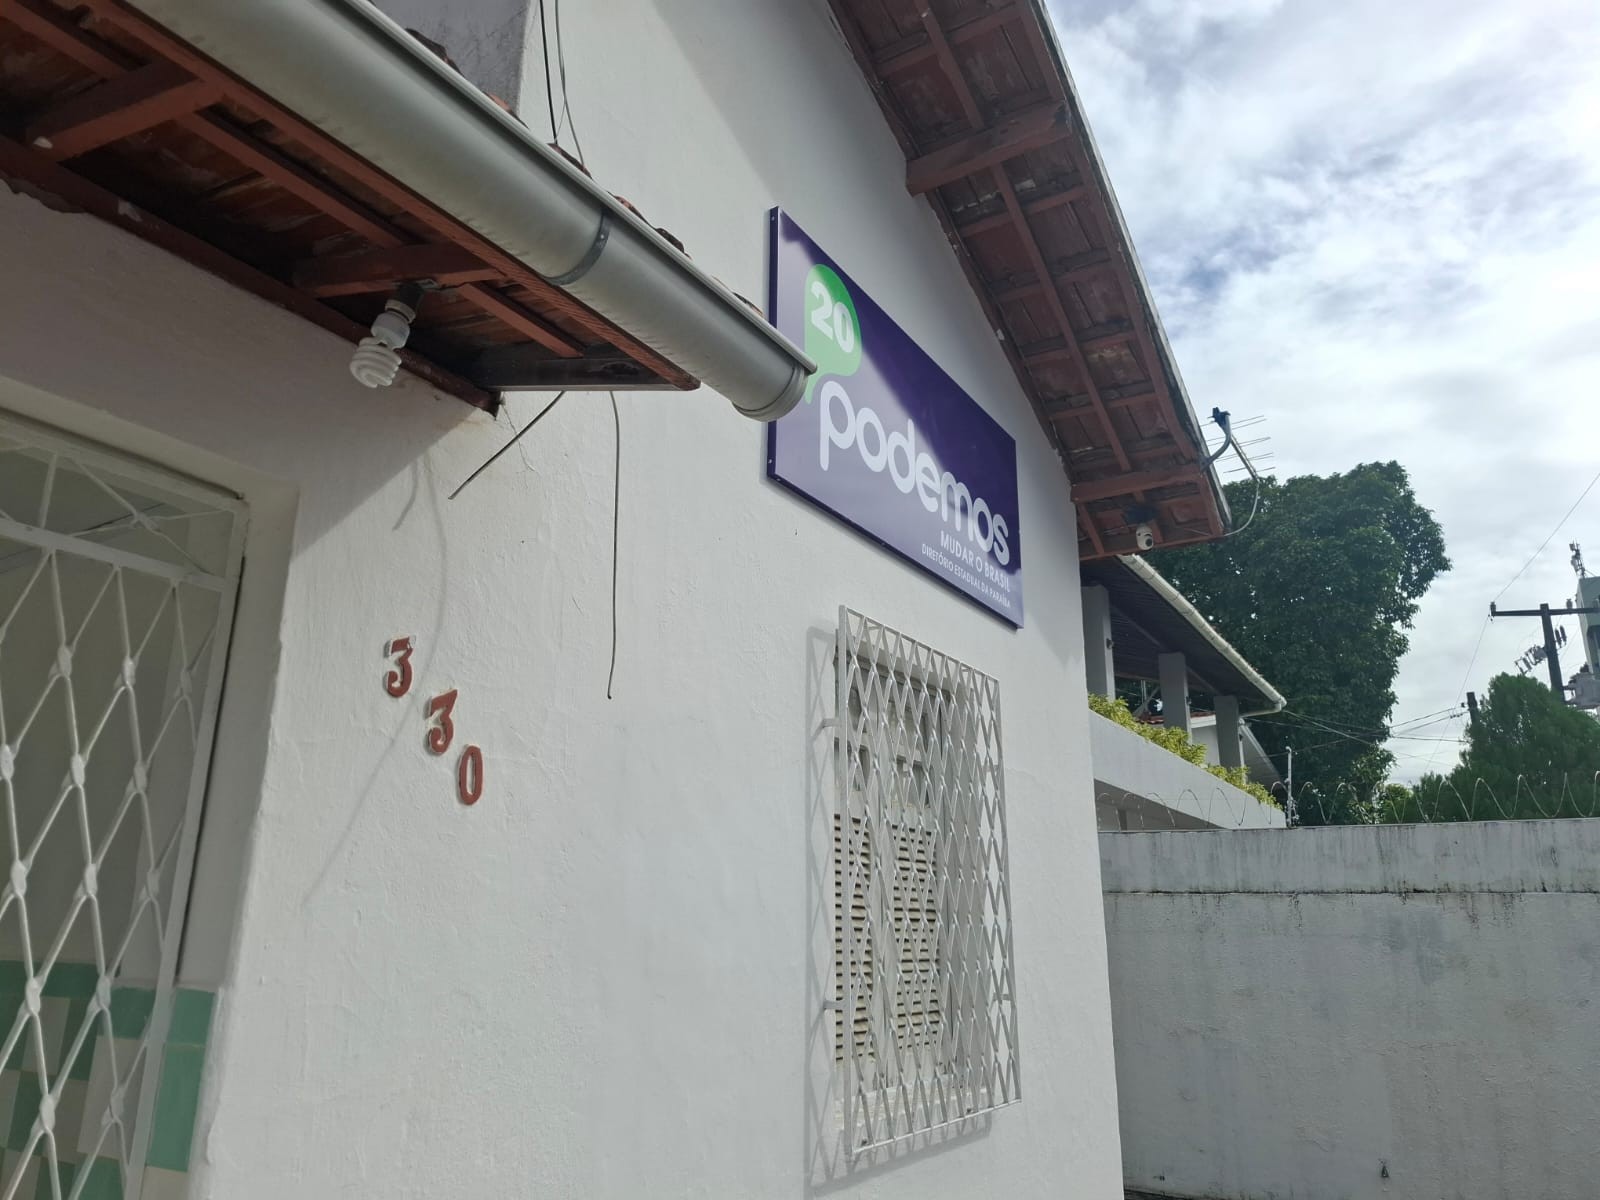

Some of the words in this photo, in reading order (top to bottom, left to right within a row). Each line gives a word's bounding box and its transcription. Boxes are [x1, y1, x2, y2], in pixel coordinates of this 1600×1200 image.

[811, 280, 855, 353] 20
[819, 380, 1010, 566] podemos
[921, 543, 954, 572] DIRETÓRIO
[954, 564, 981, 591] ESTADUAL
[940, 530, 974, 568] MUDAR
[975, 556, 983, 573] O
[984, 562, 1010, 593] BRASIL
[386, 636, 484, 806] 330
